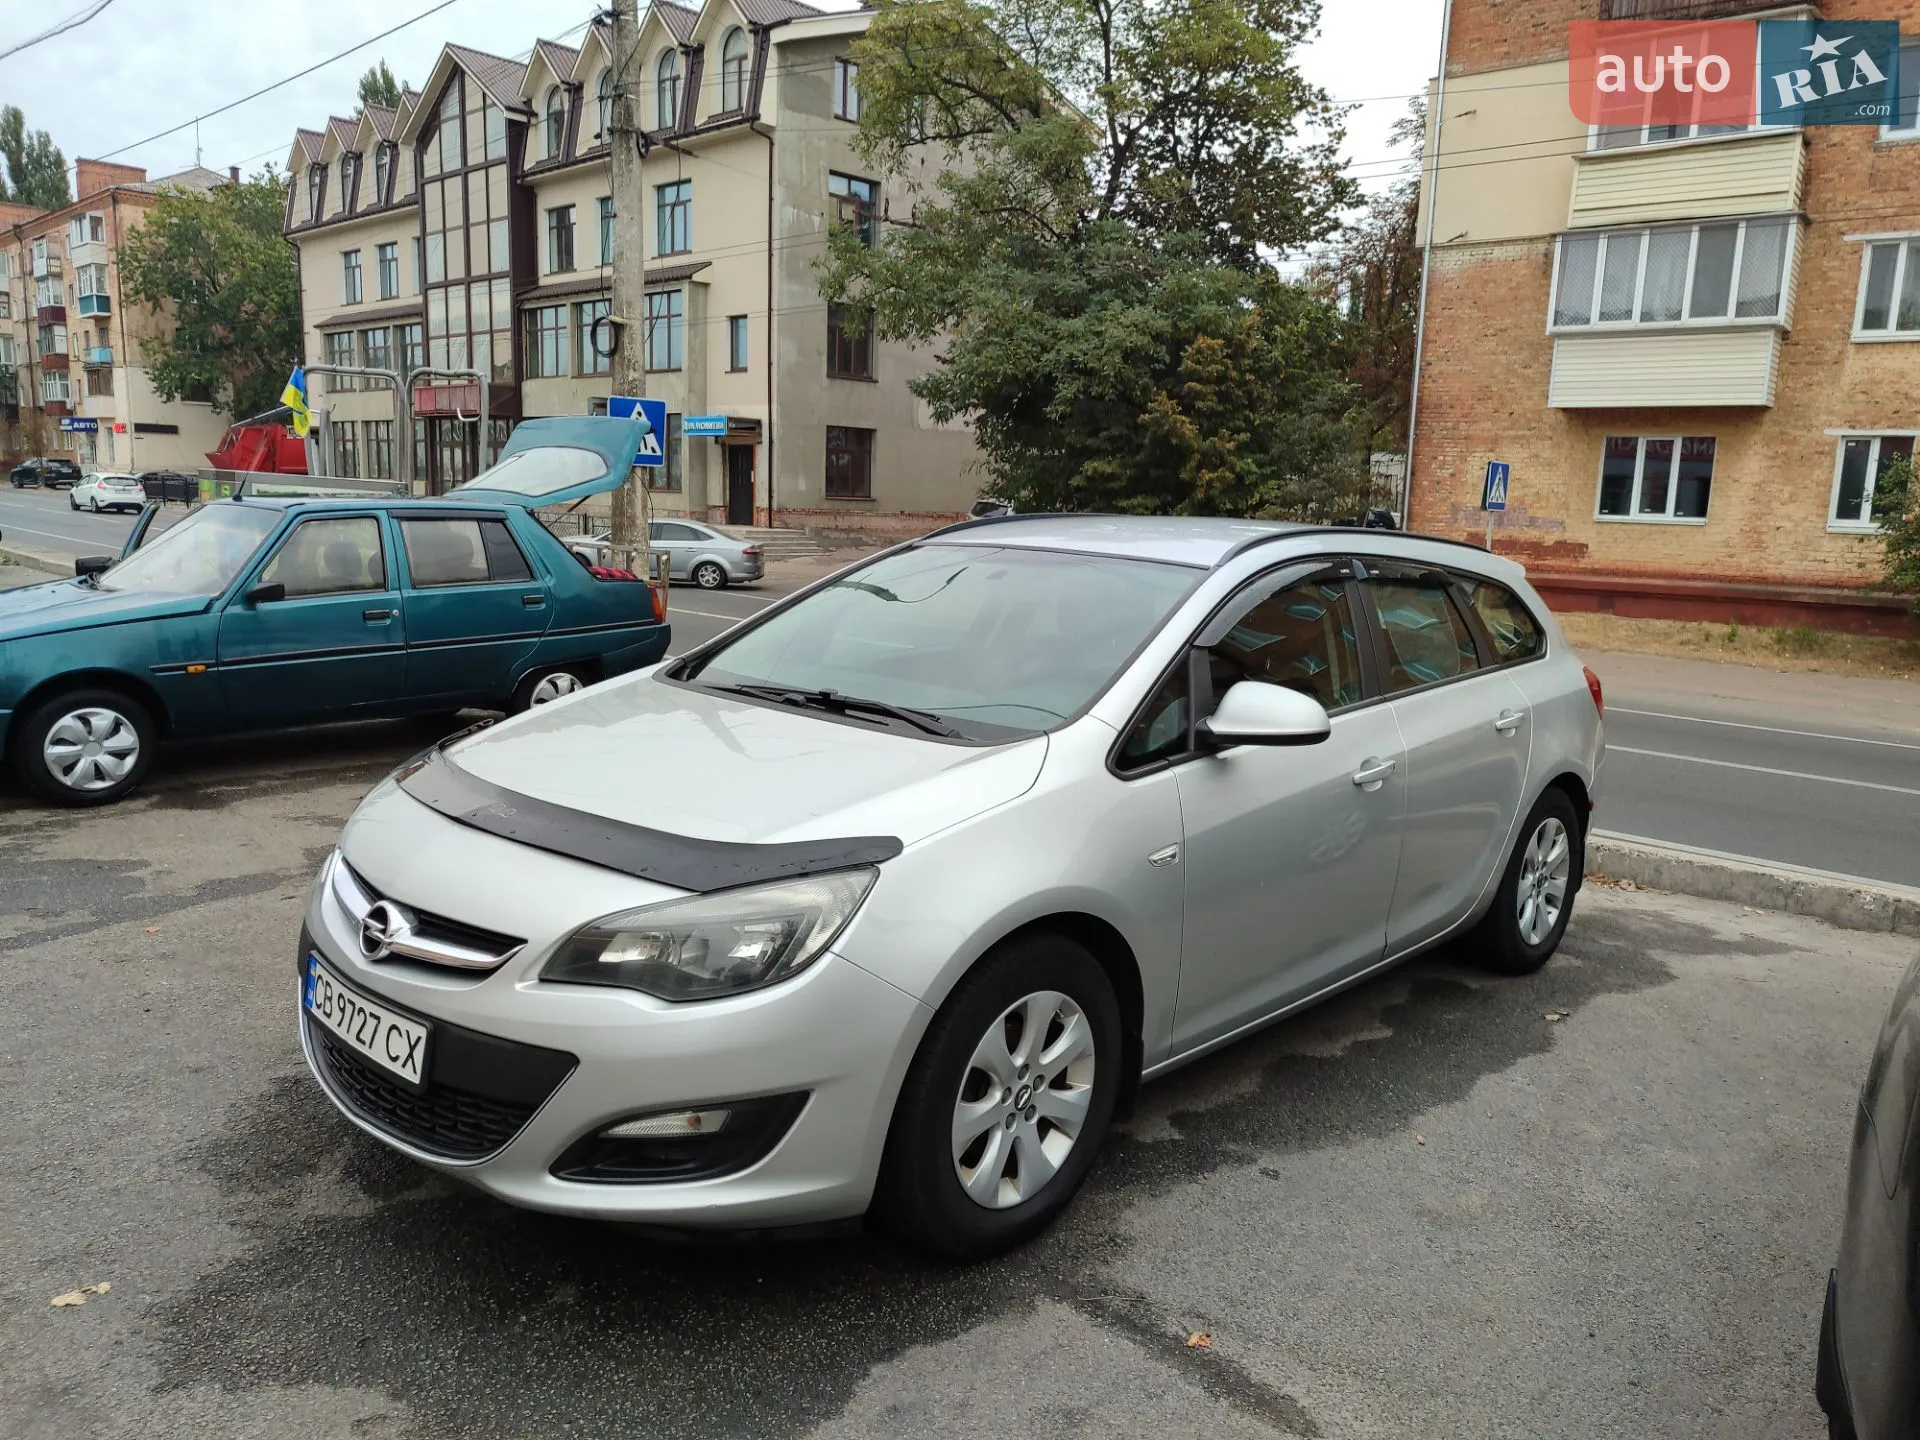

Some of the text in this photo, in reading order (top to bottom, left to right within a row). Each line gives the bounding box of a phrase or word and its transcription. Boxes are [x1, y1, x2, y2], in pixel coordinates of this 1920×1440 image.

[315, 974, 422, 1075] CB 9727 CX
